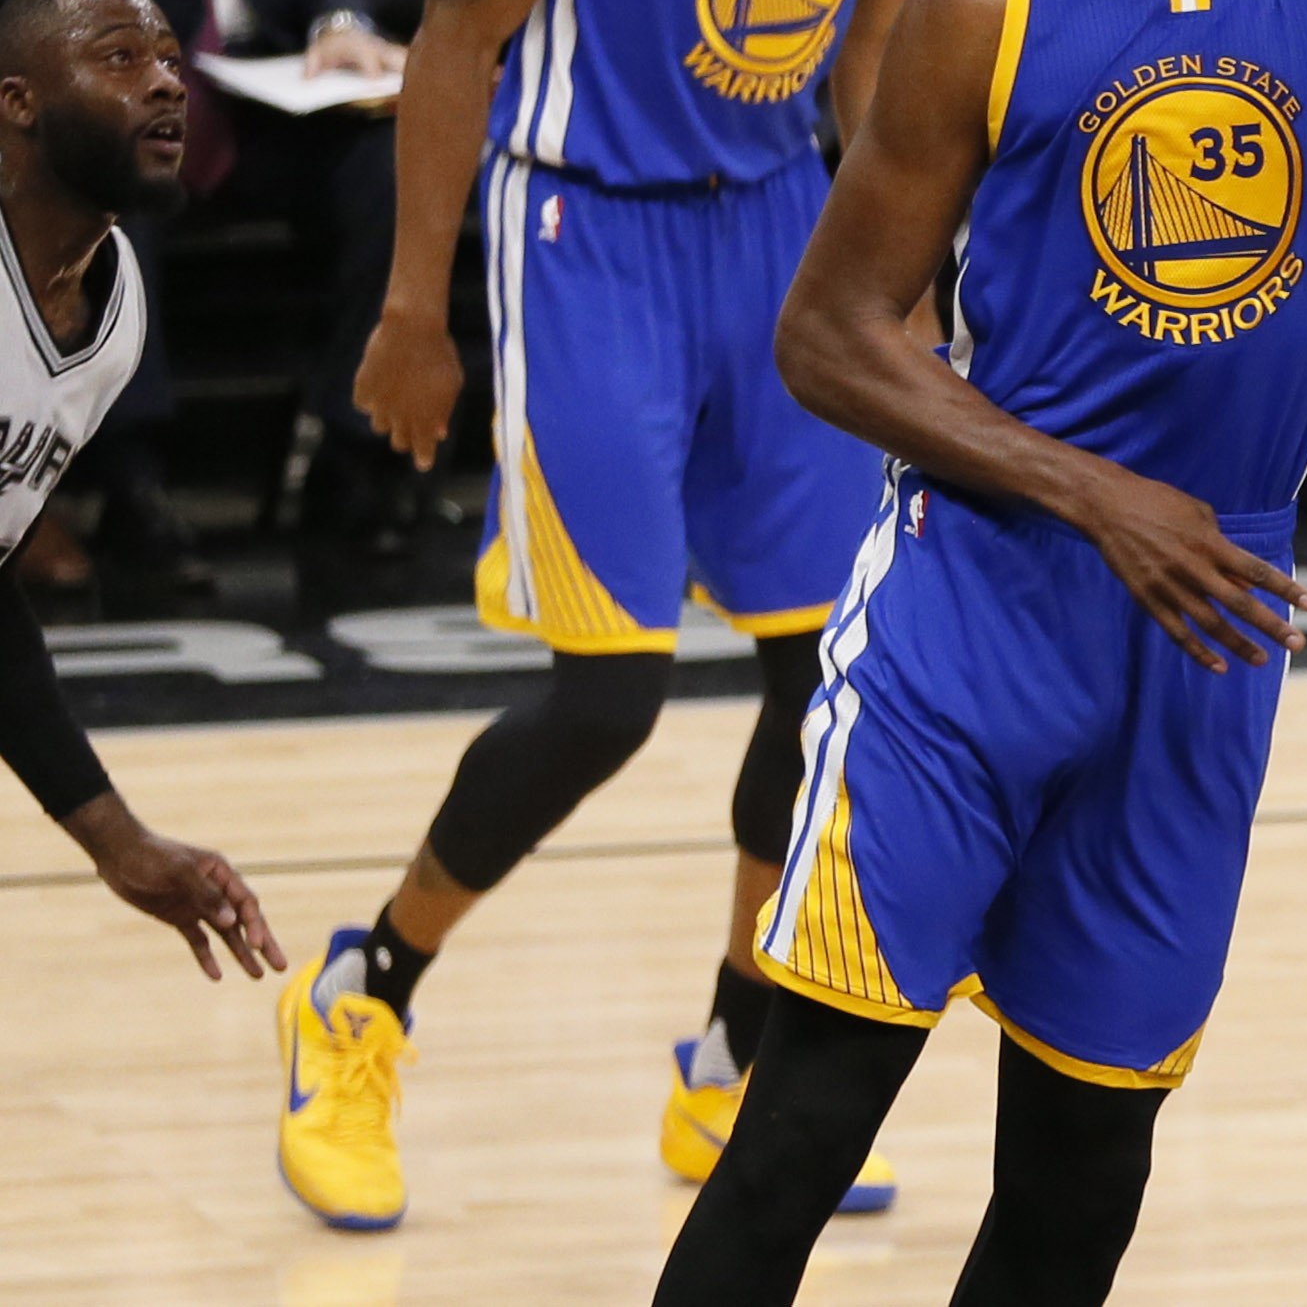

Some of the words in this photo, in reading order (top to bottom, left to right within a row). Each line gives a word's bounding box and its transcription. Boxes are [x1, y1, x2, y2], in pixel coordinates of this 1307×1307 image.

[1078, 54, 1203, 134] GOLDEN
[1216, 56, 1302, 121] STATE
[1188, 123, 1266, 182] 35
[1088, 252, 1305, 345] WARRIORS
